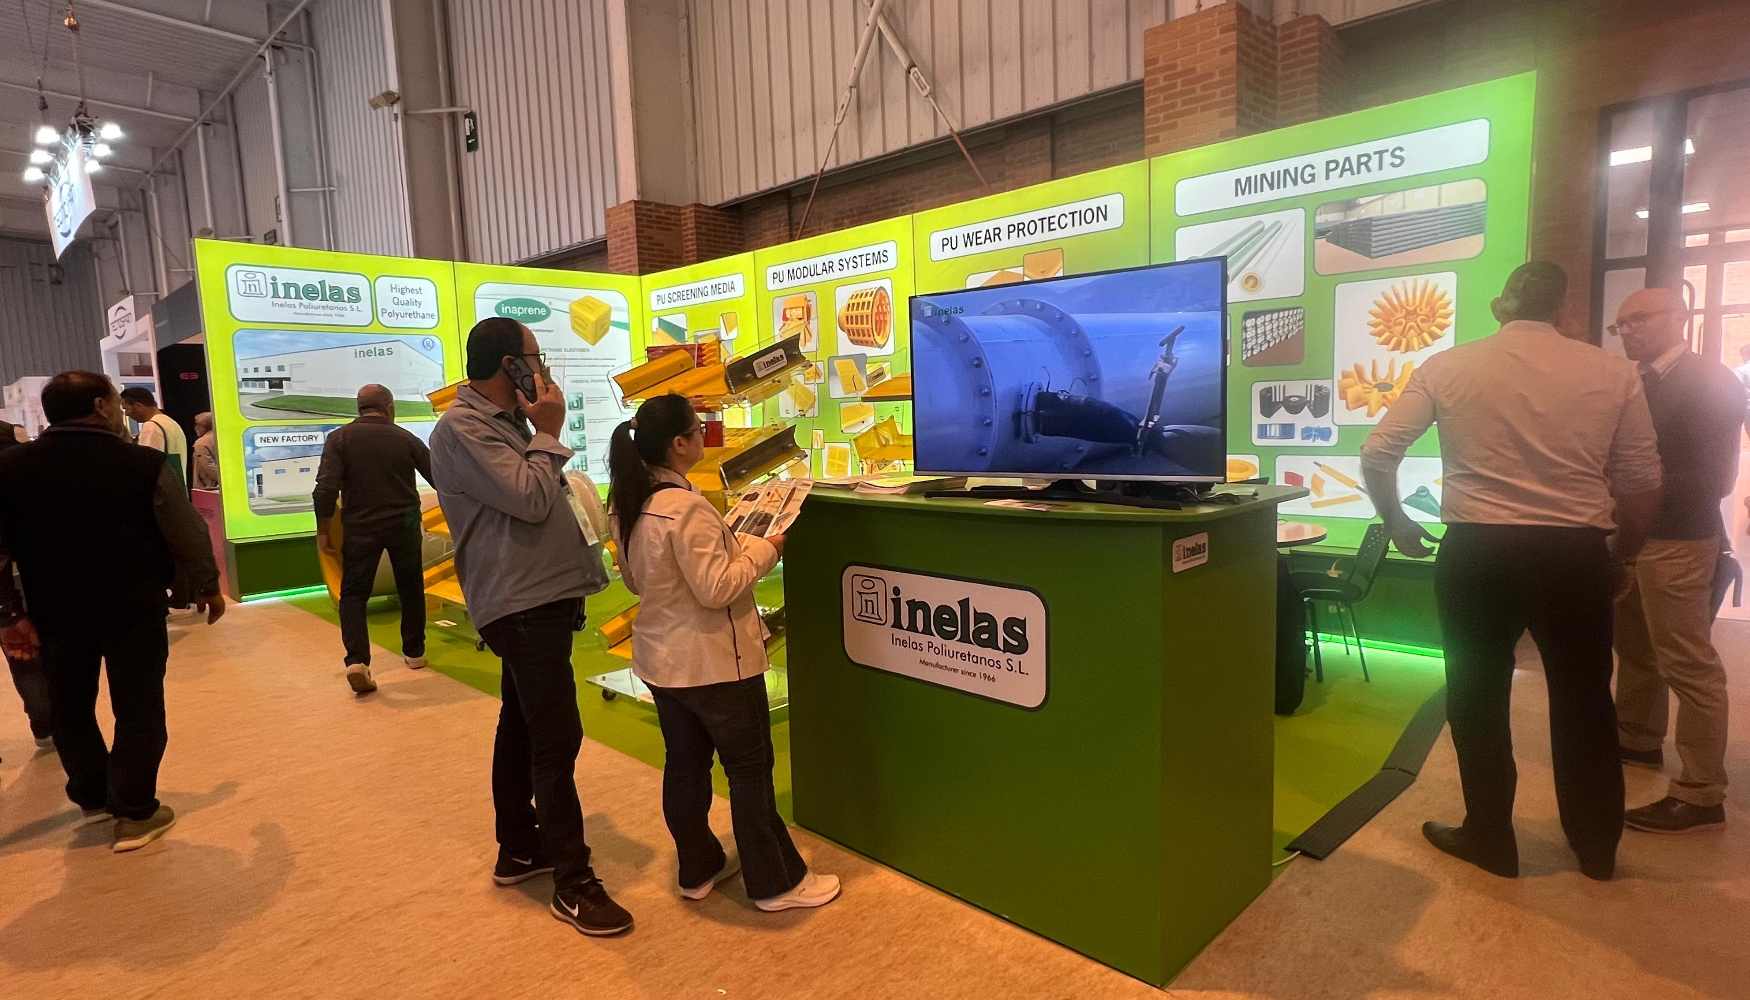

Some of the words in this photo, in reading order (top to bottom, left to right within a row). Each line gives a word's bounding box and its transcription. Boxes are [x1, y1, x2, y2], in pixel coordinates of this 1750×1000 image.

[1234, 164, 1316, 198] MINING
[1325, 146, 1406, 181] PARTS
[942, 236, 958, 252] PU
[963, 227, 1002, 248] WEAR
[1008, 204, 1108, 240] PROTECTION
[772, 270, 785, 284] PU
[787, 260, 835, 280] MODULAR
[838, 250, 889, 272] SYSTEMS
[270, 276, 362, 304] inelas
[390, 283, 422, 296] Highest
[392, 296, 423, 308] Quality
[656, 294, 666, 306] PU
[667, 285, 709, 304] SCREENING
[711, 281, 736, 297] MEDIA
[299, 302, 348, 312] Poliuretanos
[381, 308, 436, 320] Polyurethane
[501, 304, 547, 316] inaprene
[354, 347, 394, 358] inelas
[260, 435, 280, 444] NEW
[281, 434, 319, 442] FACTORY
[890, 585, 1029, 655] inelas
[891, 633, 923, 652] Inelas
[927, 642, 1001, 669] Poliuretanos
[1006, 659, 1029, 676] S.L.
[919, 658, 959, 674] Manufacturer
[961, 669, 977, 678] since
[979, 672, 996, 683] 1966
